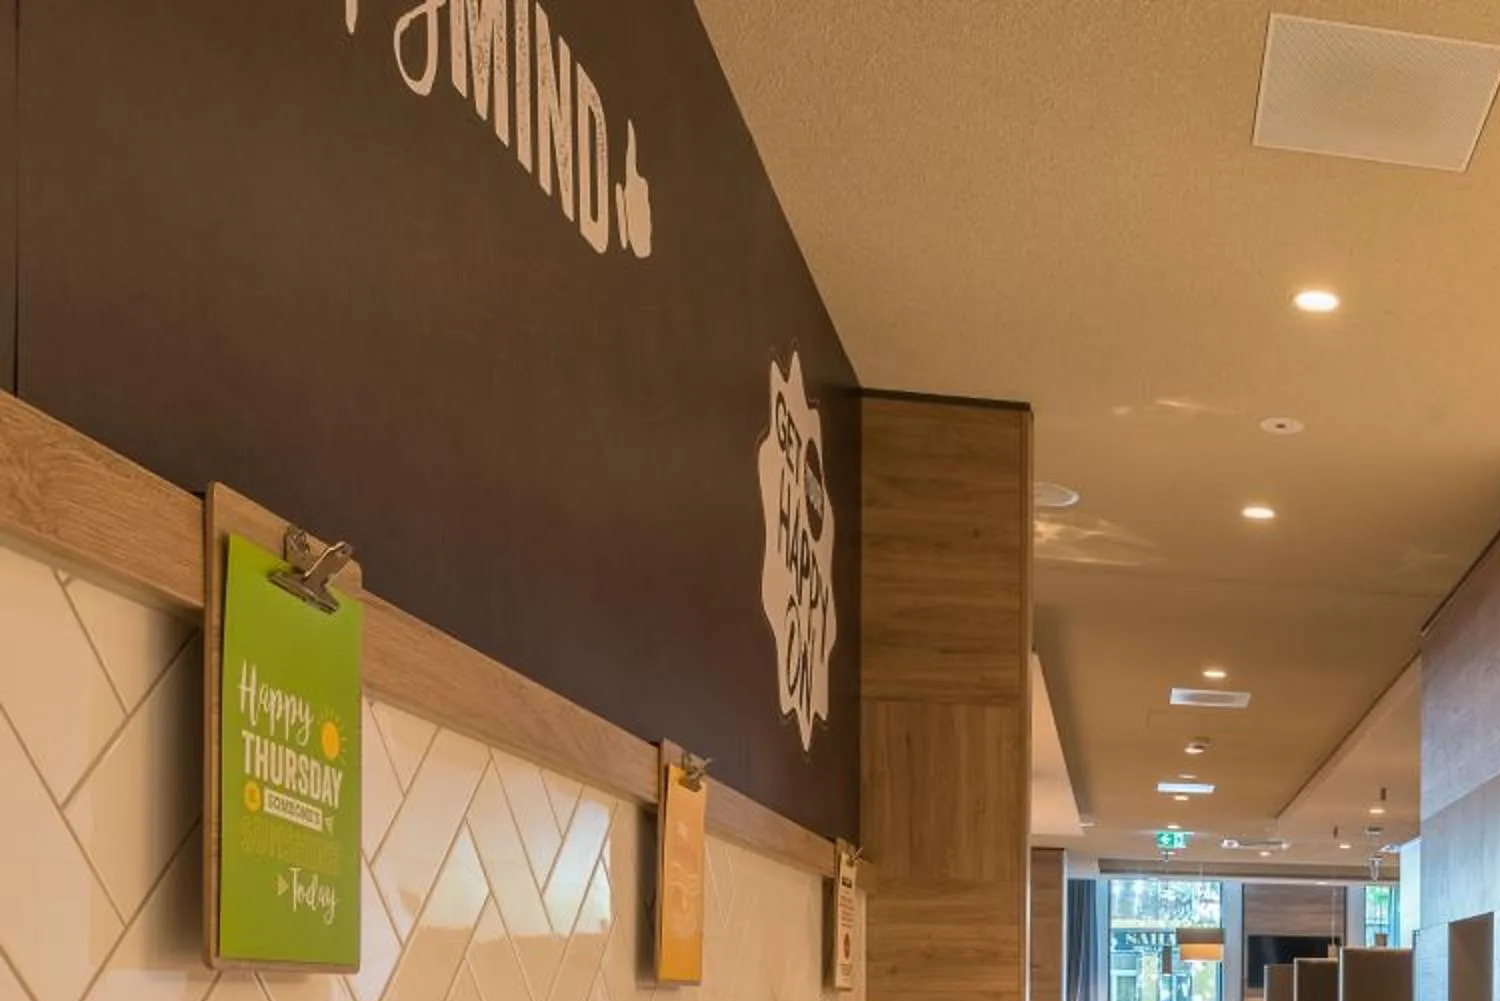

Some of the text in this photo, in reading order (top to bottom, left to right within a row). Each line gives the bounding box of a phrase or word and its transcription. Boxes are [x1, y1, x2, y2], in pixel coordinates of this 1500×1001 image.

[449, 0, 608, 253] MIND
[775, 391, 802, 485] GET
[777, 467, 829, 665] HAPPY
[237, 659, 315, 746] Happy
[786, 619, 816, 725] ON
[241, 730, 343, 809] THURSDAY
[289, 867, 338, 925] Today
